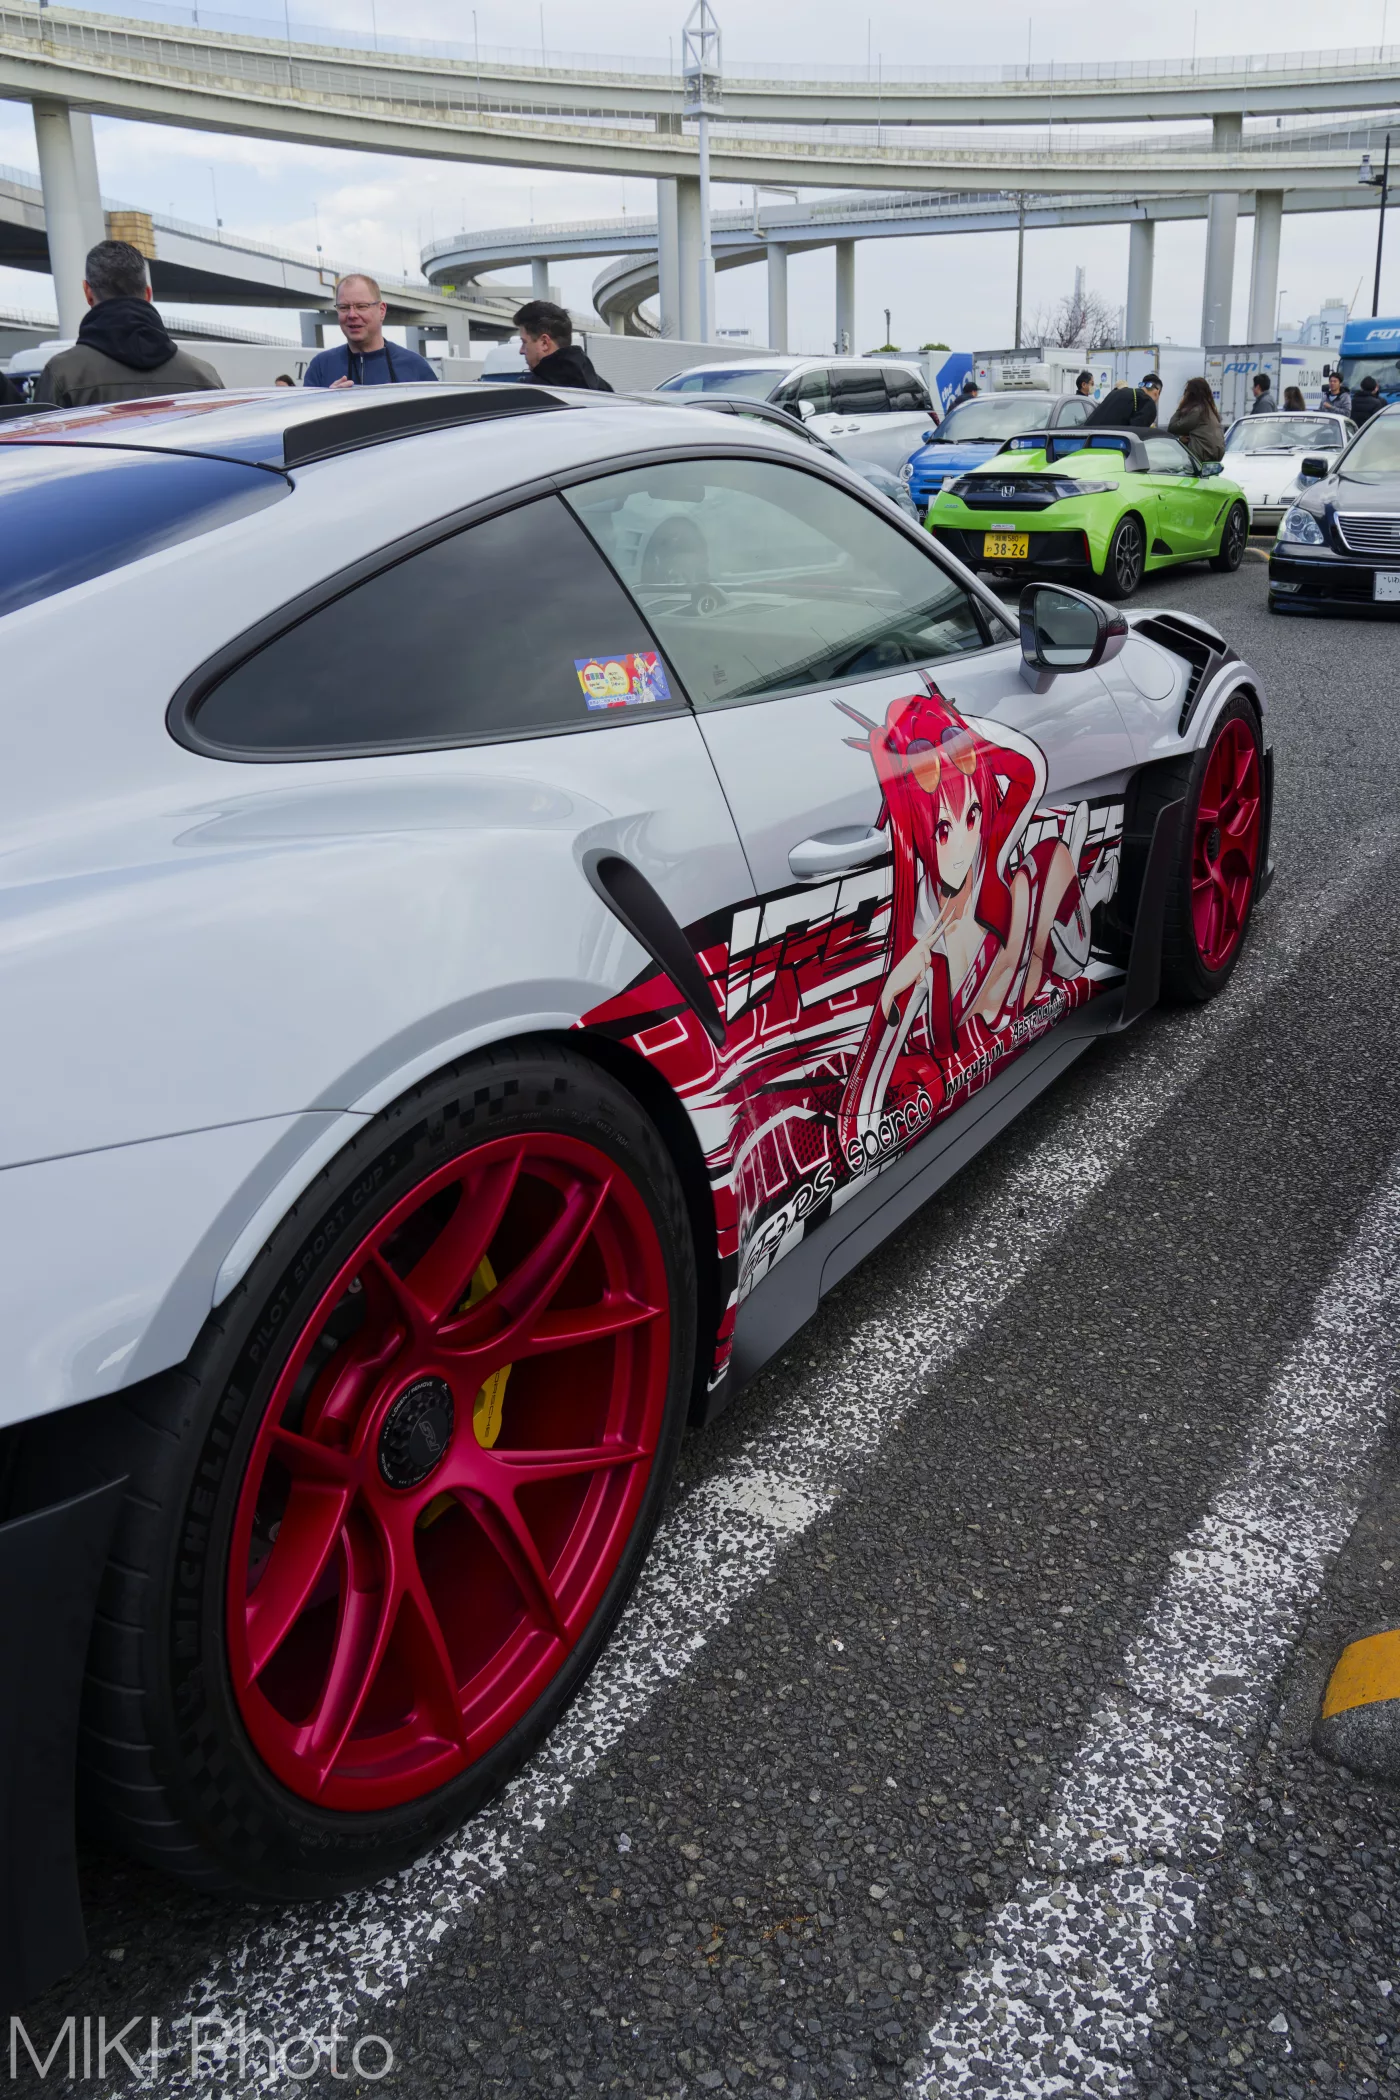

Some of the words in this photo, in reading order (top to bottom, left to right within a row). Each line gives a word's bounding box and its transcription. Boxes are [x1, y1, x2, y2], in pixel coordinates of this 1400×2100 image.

[1241, 417, 1330, 426] PORSCHE
[993, 542, 1025, 556] 38-26
[946, 1040, 1004, 1101] MICHELIN
[847, 1090, 933, 1176] sparco
[172, 1383, 246, 1660] MICHELIN
[248, 1284, 291, 1366] PILOT
[293, 1206, 347, 1284] SPORT
[352, 1166, 384, 1207] CUP
[484, 1372, 500, 1438] ORSCHE
